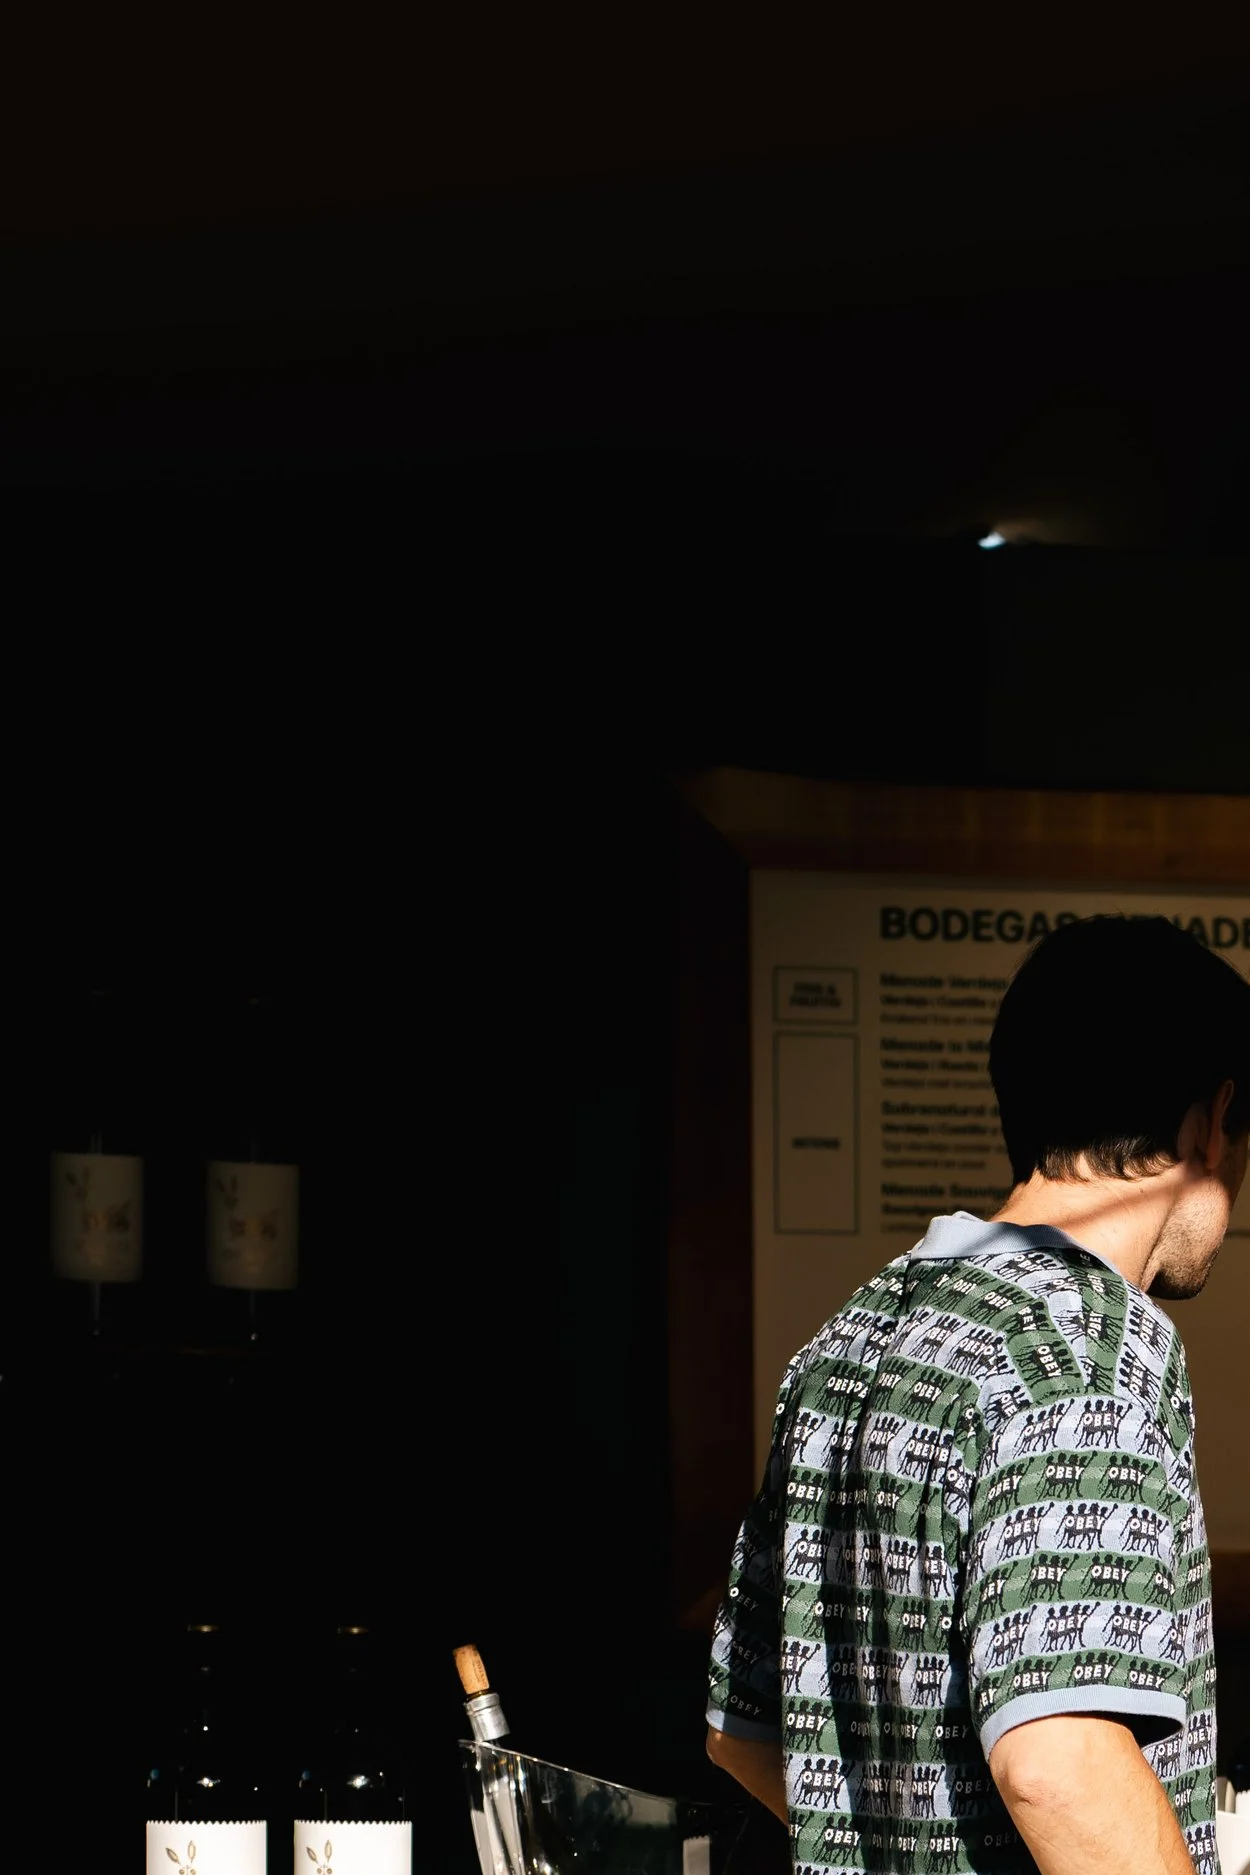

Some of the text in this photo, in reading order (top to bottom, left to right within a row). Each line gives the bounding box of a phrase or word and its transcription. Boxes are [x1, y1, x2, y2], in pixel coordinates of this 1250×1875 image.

[984, 1292, 1014, 1309] OBEY
[1019, 1307, 1037, 1332] BEY
[1038, 1346, 1062, 1378] OBEY
[1131, 1357, 1147, 1394] OBEY
[913, 1383, 941, 1399] OBEY
[1026, 1415, 1062, 1437] OBEY
[1083, 1414, 1120, 1429] OBEY
[1045, 1465, 1084, 1479] OBEY
[1109, 1467, 1145, 1484] OBEY
[787, 1482, 823, 1502] OBEY
[988, 1476, 1022, 1499] OBEY
[1004, 1521, 1040, 1539] OBEY
[1065, 1515, 1104, 1529] OBEY
[1130, 1518, 1159, 1536] OBE
[1091, 1565, 1130, 1582] OBEY
[1047, 1614, 1087, 1631] OBEY
[1113, 1615, 1149, 1635] OBEY
[915, 1669, 943, 1684] OBEY
[1013, 1671, 1051, 1688] OBEY
[1073, 1665, 1114, 1679] OBEY
[1129, 1670, 1165, 1688] OBEY
[787, 1713, 827, 1731] OBEY
[935, 1725, 969, 1738] OBEY
[1157, 1740, 1181, 1755] OBE
[803, 1771, 844, 1789] OBEY
[956, 1779, 993, 1794] OBEY
[825, 1828, 861, 1845] OBEY
[930, 1836, 959, 1851] OBEY
